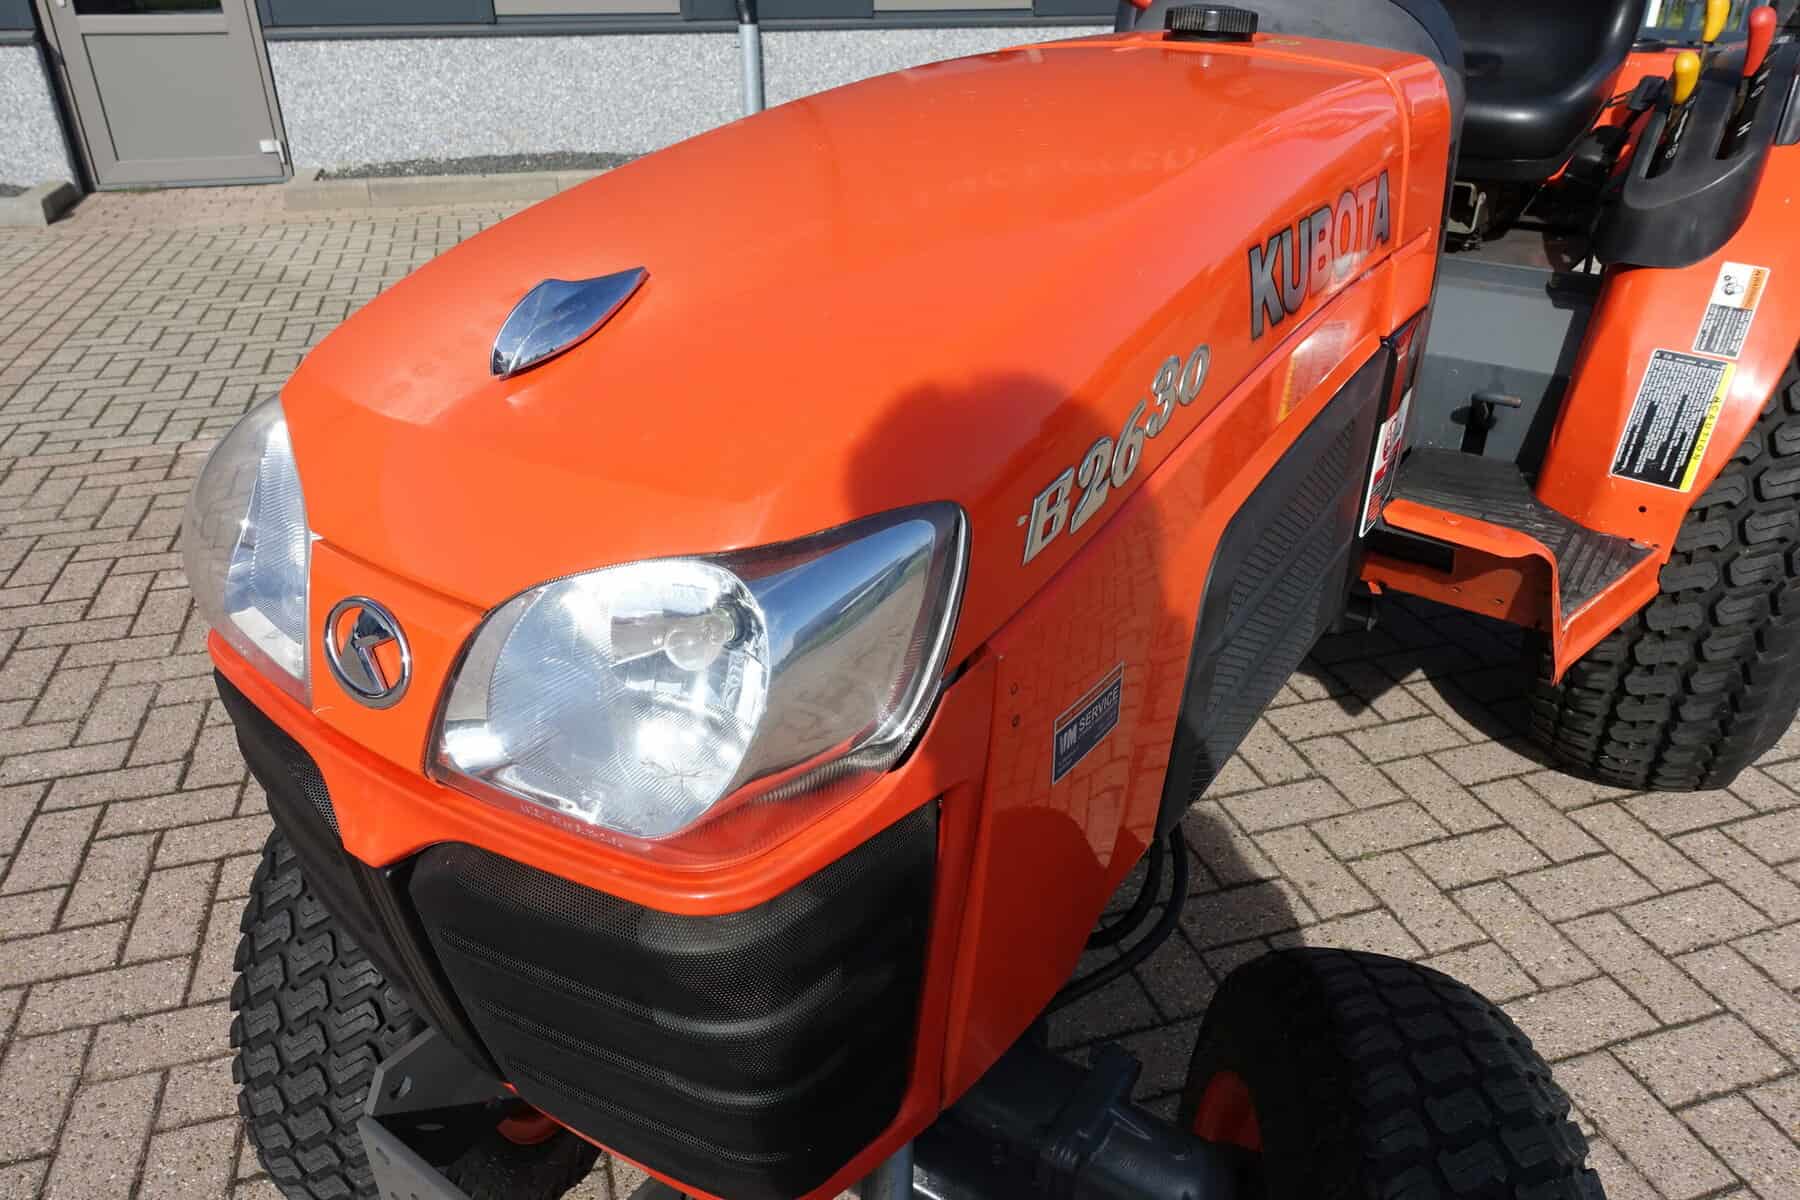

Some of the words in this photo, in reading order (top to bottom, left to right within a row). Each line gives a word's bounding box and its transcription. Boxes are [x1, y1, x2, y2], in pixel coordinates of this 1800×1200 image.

[1247, 168, 1391, 342] KUBOTA
[1021, 343, 1212, 567] B2630
[1690, 401, 1723, 462] CAUTION
[1079, 685, 1120, 732] SERVICE
